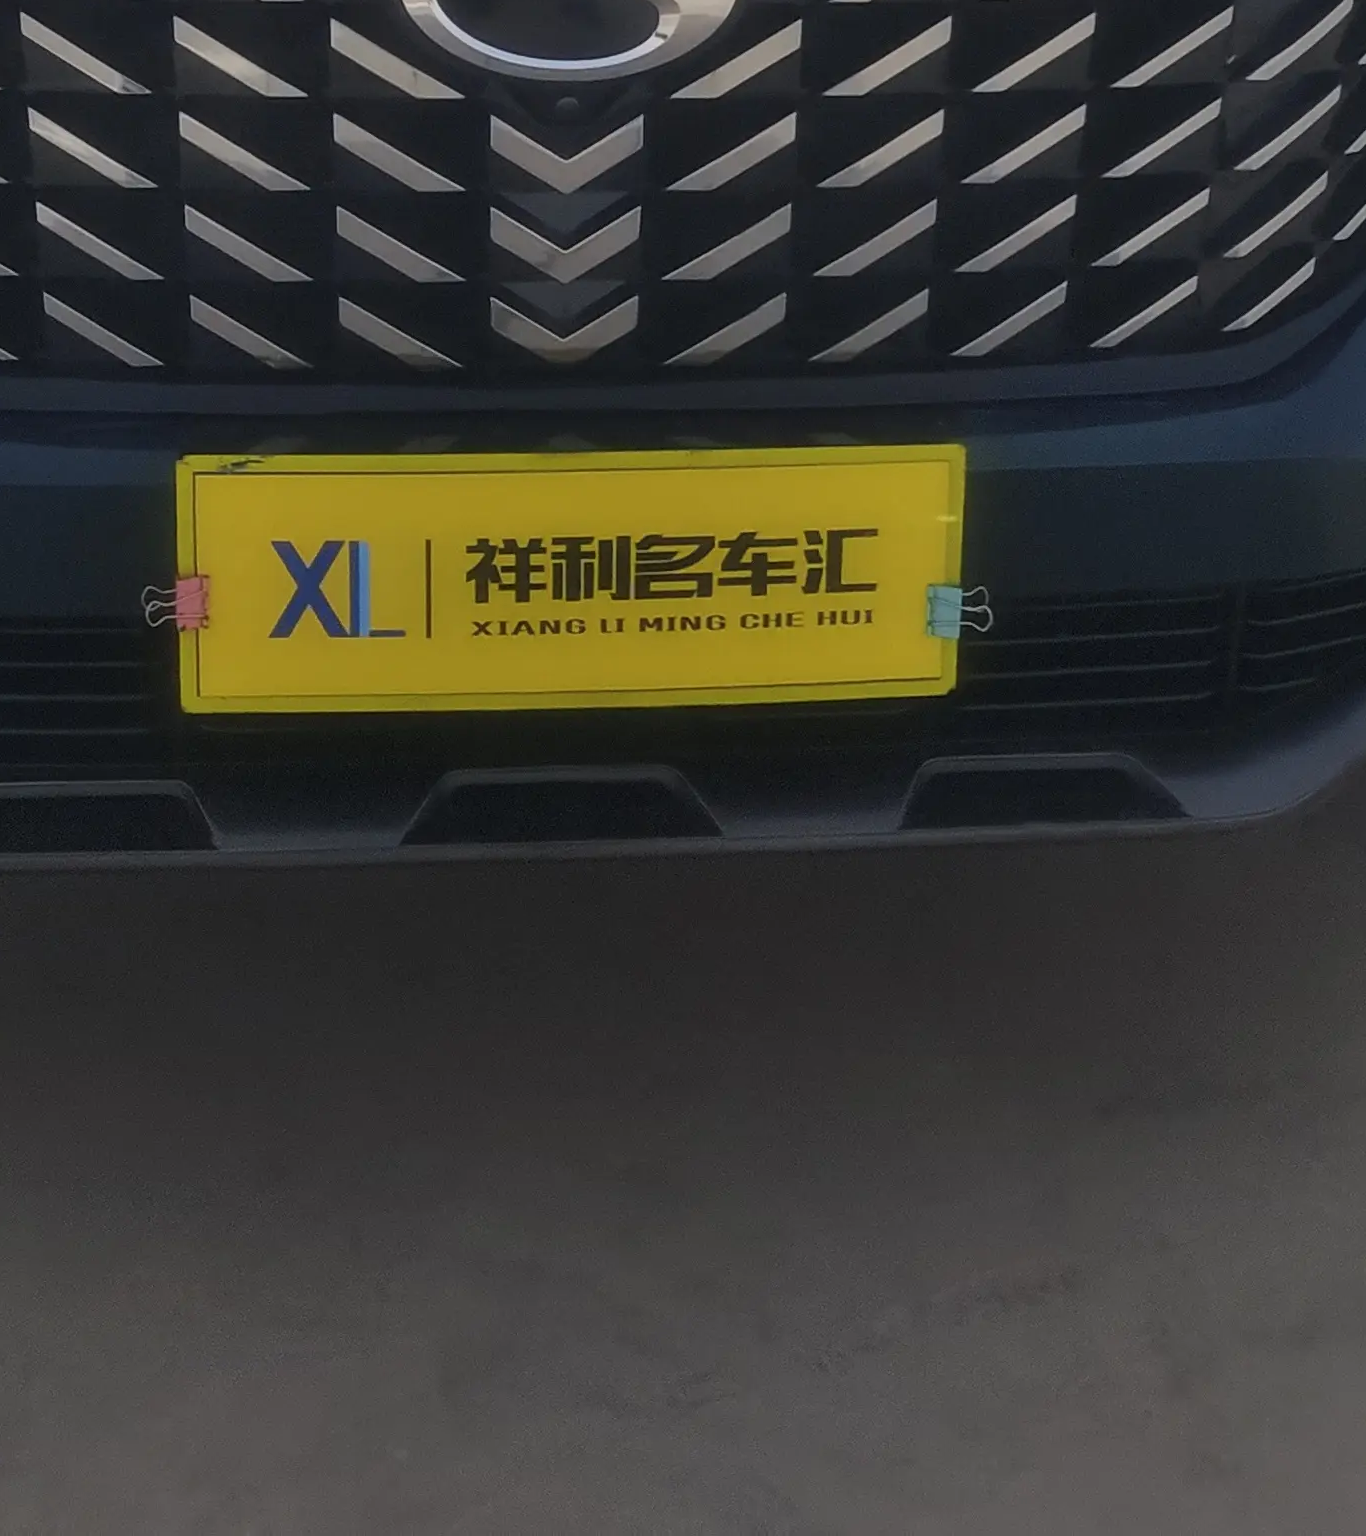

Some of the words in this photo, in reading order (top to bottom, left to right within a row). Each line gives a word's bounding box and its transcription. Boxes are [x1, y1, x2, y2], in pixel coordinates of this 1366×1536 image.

[269, 540, 406, 638] XL
[465, 528, 879, 604] 祥利名车汇
[471, 618, 587, 637] XIANG
[600, 617, 624, 634] LI
[638, 614, 726, 633] MING
[739, 611, 805, 631] CHE
[816, 608, 874, 627] HUI
